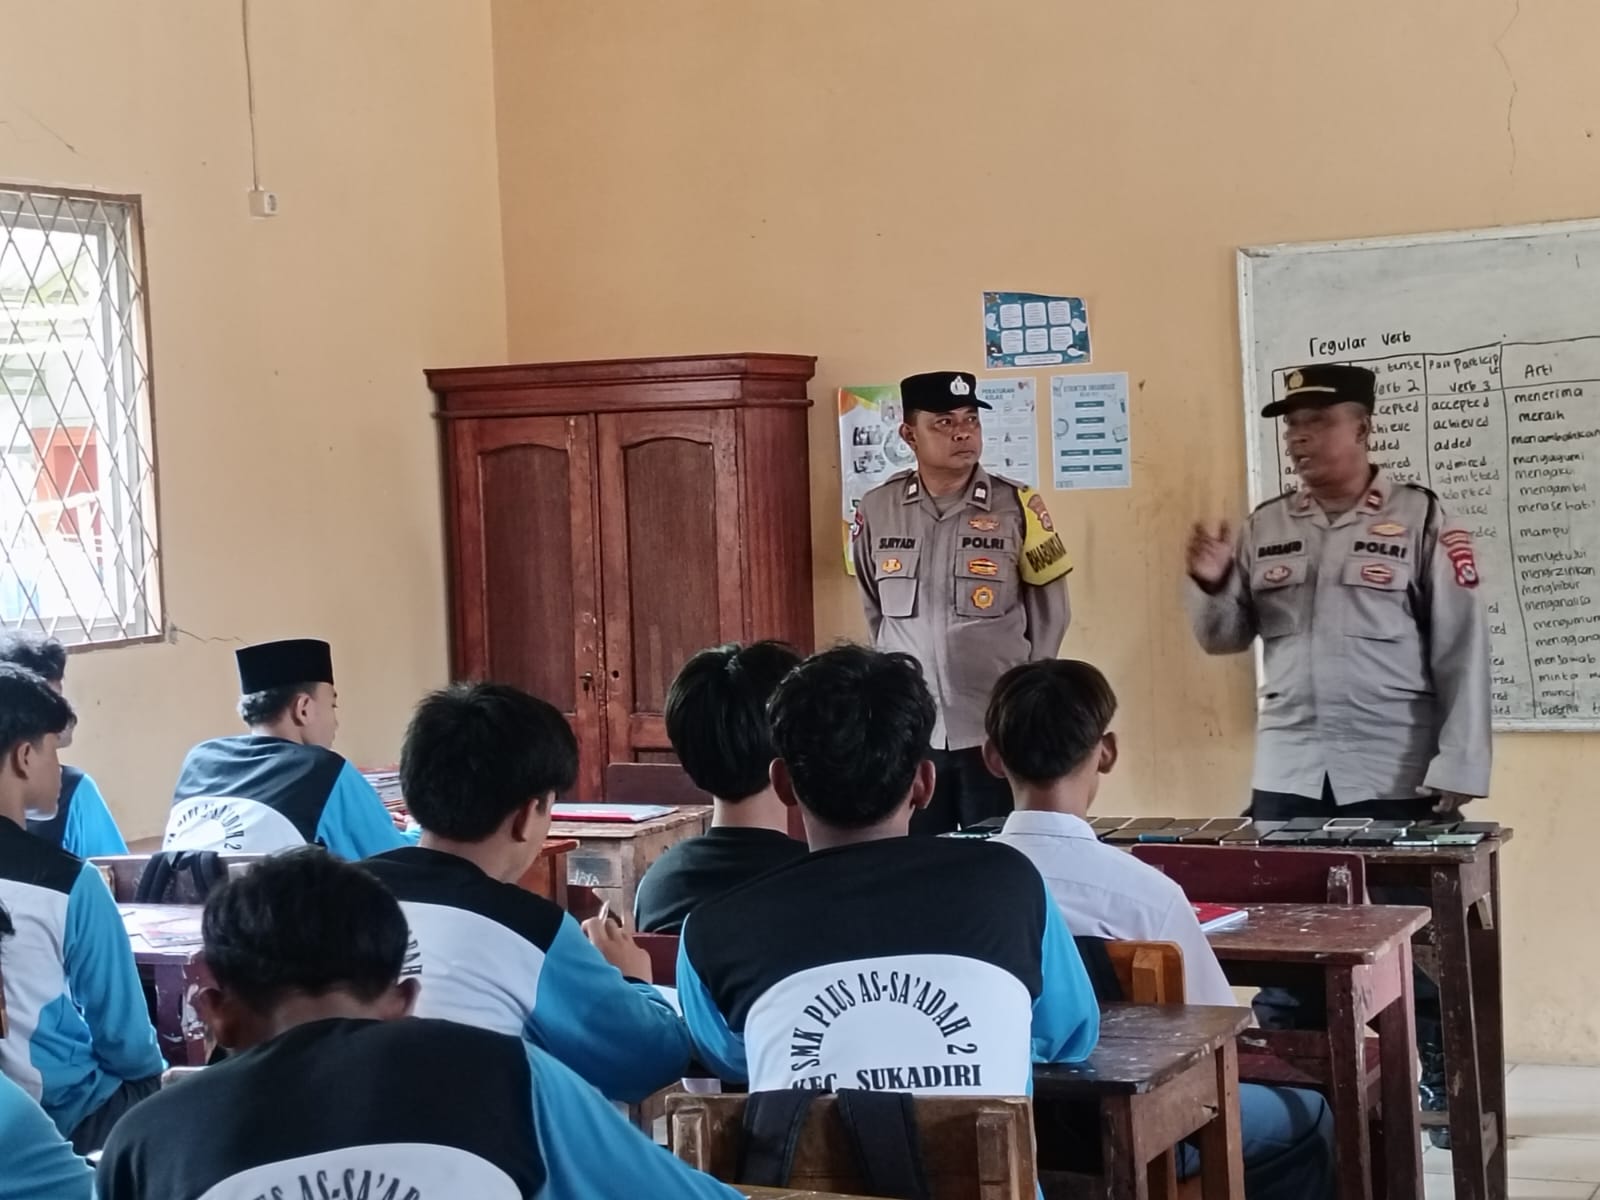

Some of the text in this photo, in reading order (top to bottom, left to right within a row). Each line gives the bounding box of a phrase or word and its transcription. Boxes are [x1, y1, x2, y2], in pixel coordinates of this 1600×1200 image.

[1309, 337, 1367, 357] regular
[1524, 363, 1553, 379] Arti
[1407, 378, 1420, 393] 2
[1482, 379, 1491, 392] 3
[1514, 387, 1584, 403] menerima
[1432, 396, 1490, 413] accepted
[1433, 415, 1489, 430] achieved
[1433, 437, 1472, 452] added
[1520, 526, 1569, 538] mampu
[962, 536, 1005, 550] POLRI
[1353, 540, 1407, 559] POLRI
[1539, 671, 1579, 682] minta
[803, 978, 857, 1029] PLUS
[790, 1026, 825, 1072] SMK
[946, 1042, 978, 1056] 2
[855, 1063, 982, 1091] SUKADIRI
